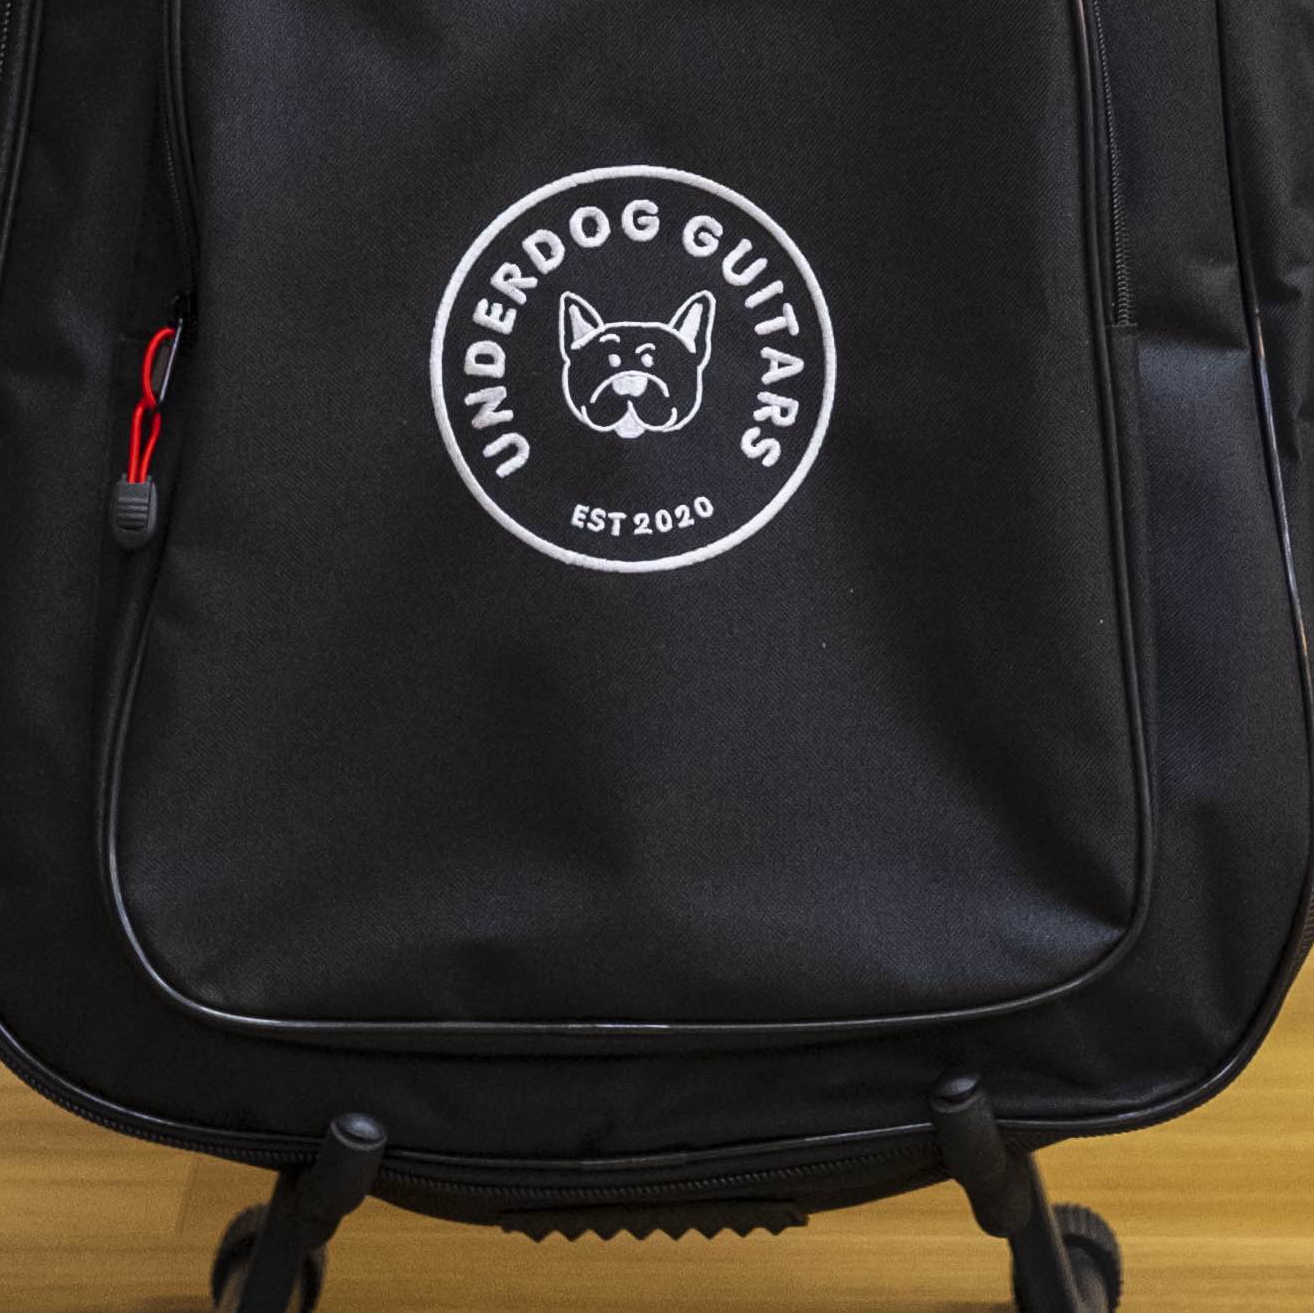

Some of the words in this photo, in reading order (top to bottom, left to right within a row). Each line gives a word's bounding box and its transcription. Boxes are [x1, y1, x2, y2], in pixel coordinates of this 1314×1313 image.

[464, 199, 660, 478] UNDERDOG
[682, 215, 805, 468] GUITARS
[571, 503, 626, 536] EST
[632, 495, 715, 536] 2020
